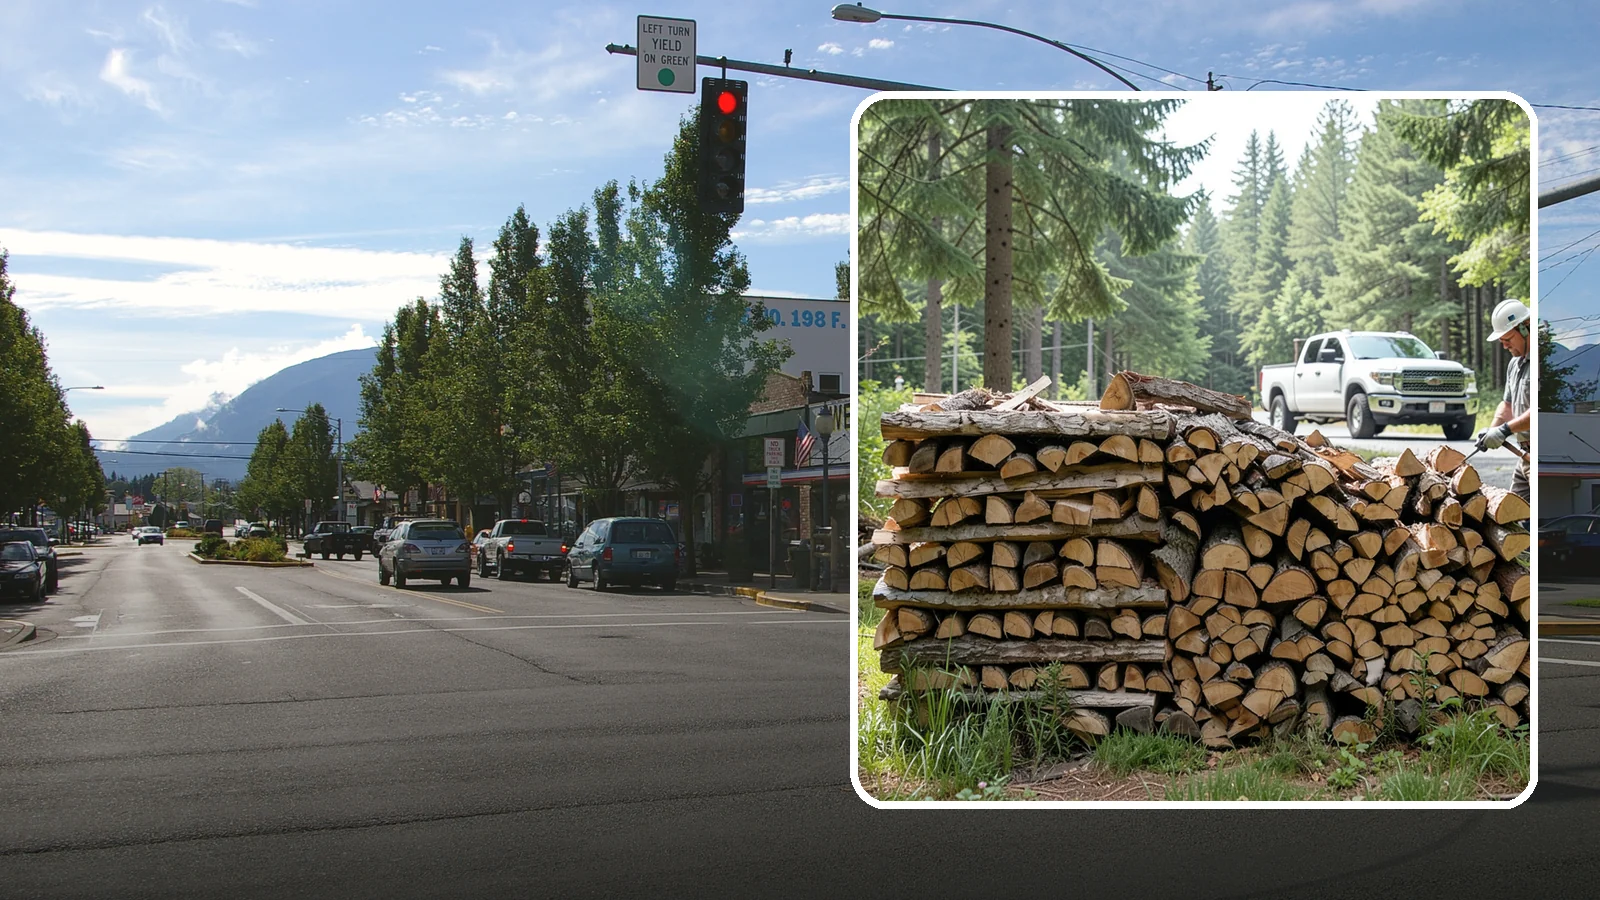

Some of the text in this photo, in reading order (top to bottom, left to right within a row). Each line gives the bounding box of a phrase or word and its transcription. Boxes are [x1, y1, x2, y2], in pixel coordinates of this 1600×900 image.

[642, 23, 690, 37] LEFT TURN
[652, 38, 682, 52] YIELD
[644, 53, 689, 66] ON GREEN
[791, 309, 826, 328] 198
[831, 311, 846, 329] F.
